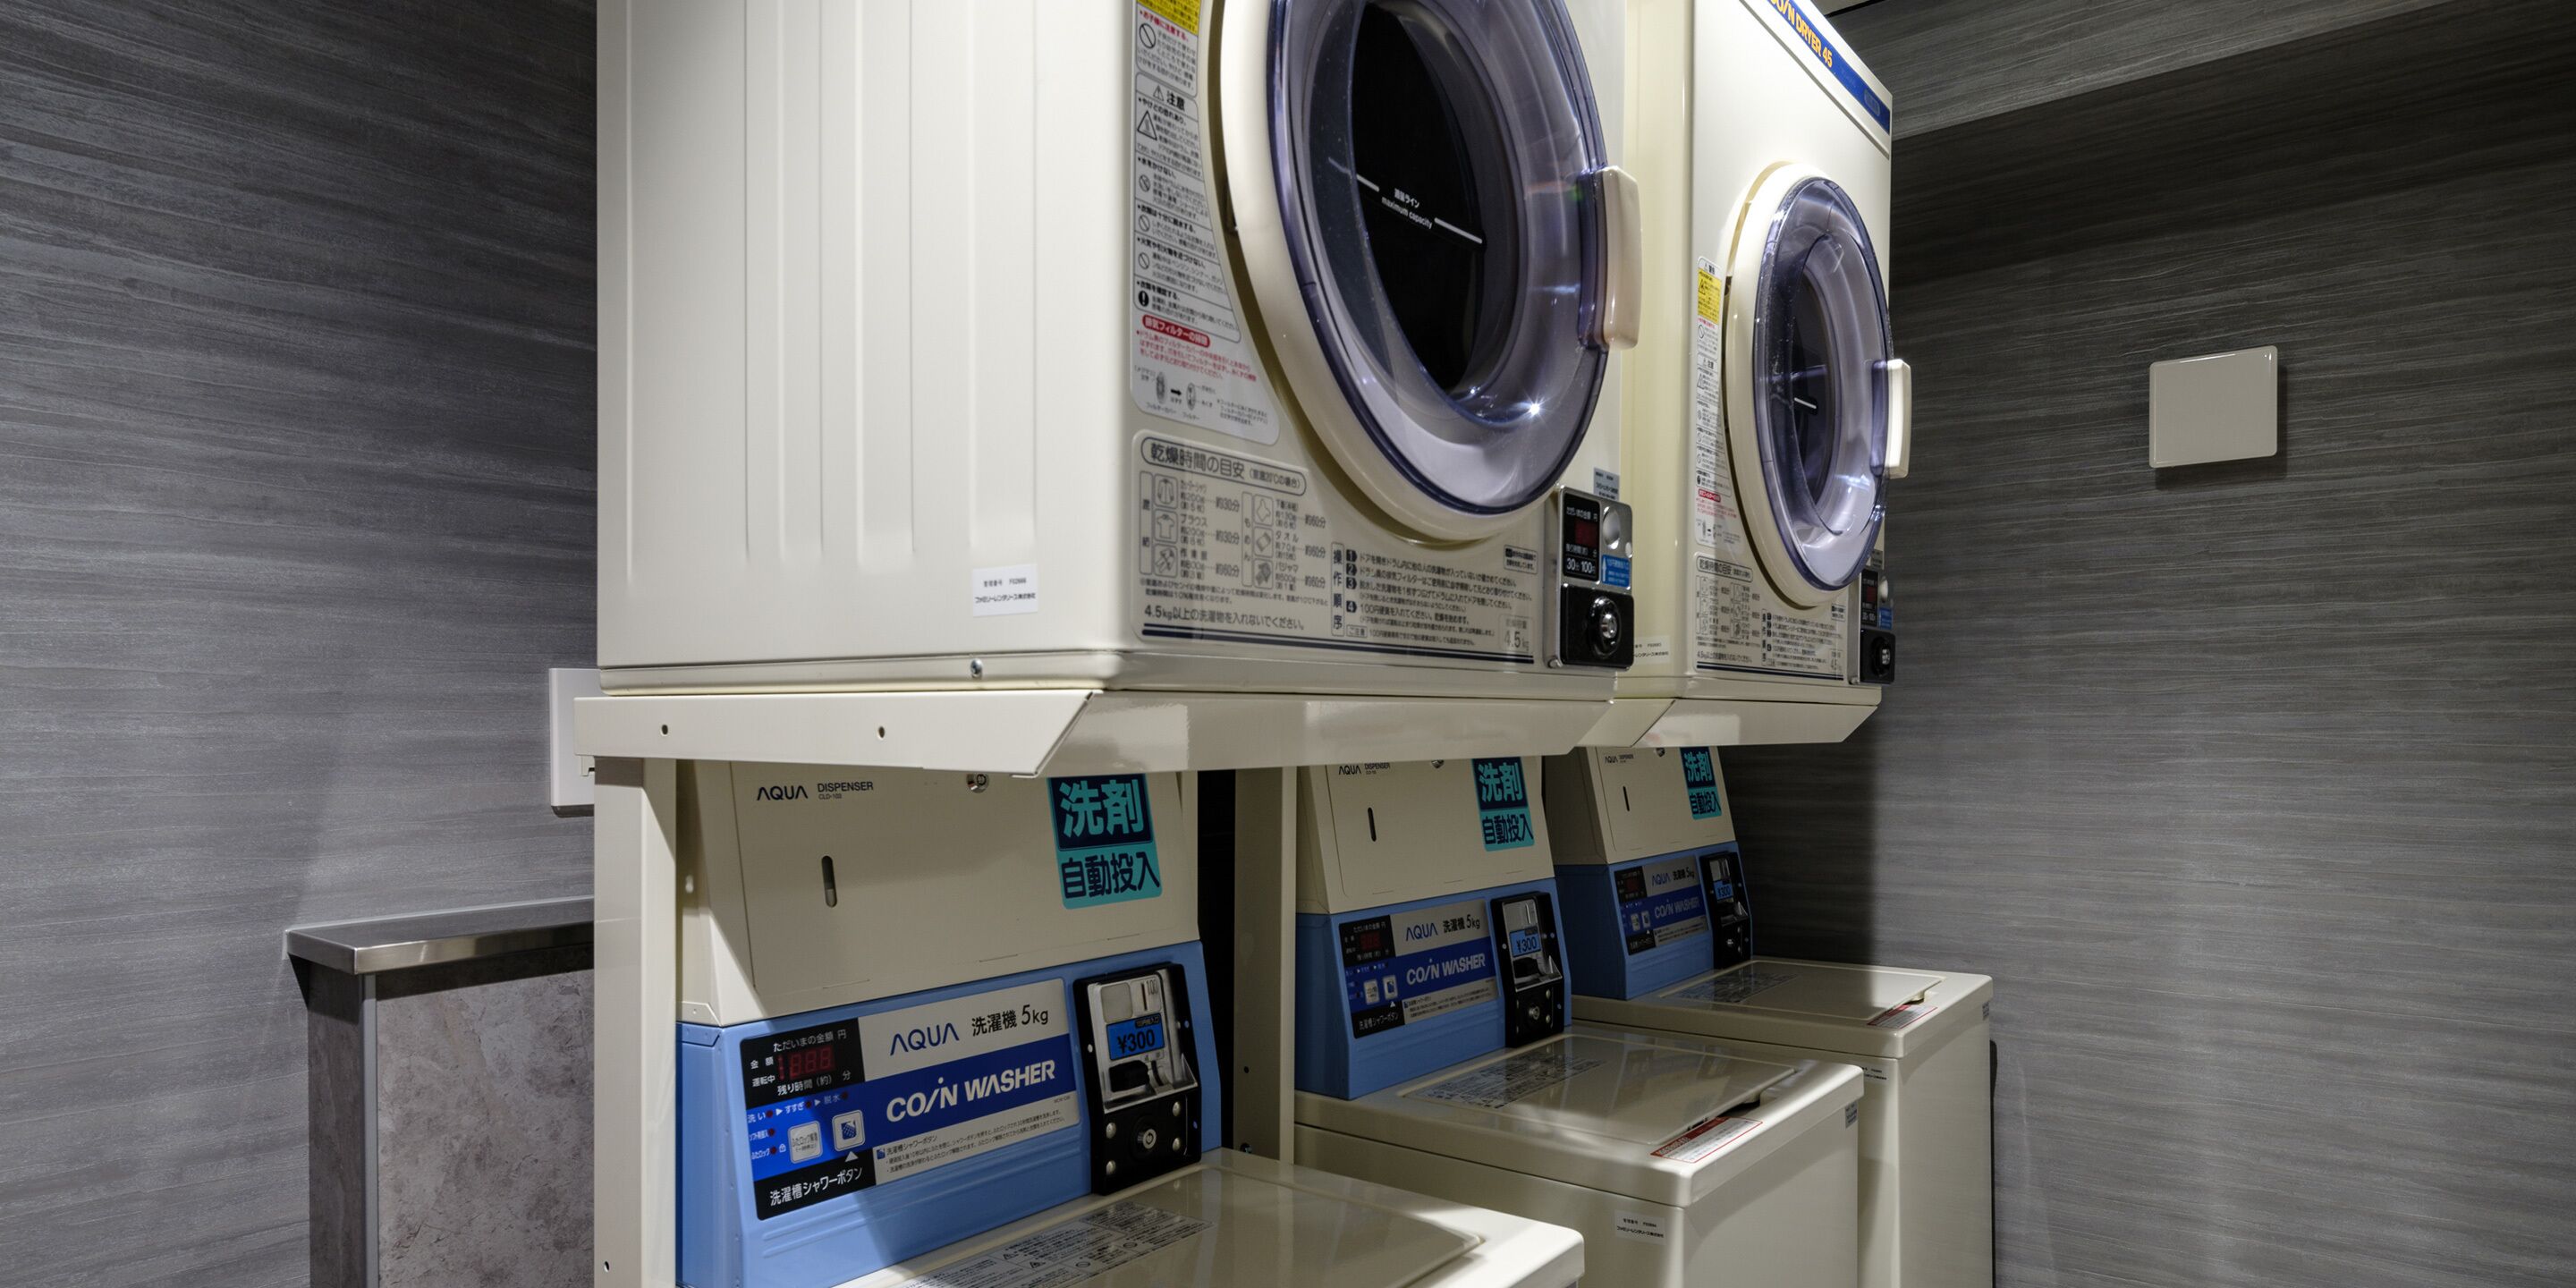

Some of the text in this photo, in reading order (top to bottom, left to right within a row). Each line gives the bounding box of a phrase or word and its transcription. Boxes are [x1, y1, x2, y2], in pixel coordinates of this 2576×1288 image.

[1796, 16, 1821, 57] DRYER
[1823, 47, 1833, 68] 45
[1166, 91, 1185, 111] 注意
[1141, 157, 1176, 179] 水をかけない。
[1381, 196, 1433, 229] maximum capacity
[1150, 443, 1245, 479] 乾燥時間の目安
[1216, 496, 1240, 512] 約30分
[1334, 549, 1342, 630] 操作順序
[1145, 605, 1304, 630] 4.5kg以上の洗濯物を入れないでください。
[1338, 765, 1362, 775] AQUA
[1365, 762, 1391, 770] DISPENSER
[1685, 752, 1713, 782] 洗剤
[757, 782, 874, 801] AQUA DISPENSER
[1479, 762, 1523, 801] 洗剤
[1059, 779, 1145, 837] 洗剤
[1689, 792, 1721, 815] 自動投入
[1483, 814, 1533, 844] 自動投入
[1061, 852, 1160, 899] 自動投入
[1651, 873, 1671, 886] AQUA
[1654, 899, 1674, 919] COIN
[1405, 914, 1480, 942] AQUA 洗濯機 5kg
[1516, 936, 1538, 953] ¥300
[1406, 953, 1486, 986] COIN WASHER
[1147, 979, 1158, 996] 100
[774, 1030, 847, 1052] ただいまの金額 円
[890, 1004, 1049, 1056] AQUA 洗濯機 5kg
[1117, 1030, 1155, 1054] ¥300
[750, 1057, 774, 1070] 金額
[751, 1075, 775, 1087] 運転中
[843, 1071, 852, 1080] 分
[886, 1059, 1055, 1123] COIN WASHER
[748, 1113, 766, 1123] 洗い
[785, 1102, 805, 1114] すすぎ
[886, 1135, 937, 1156] 洗濯槽シャワーボタン
[769, 1167, 862, 1207] 洗濯槽シャワーボタン
